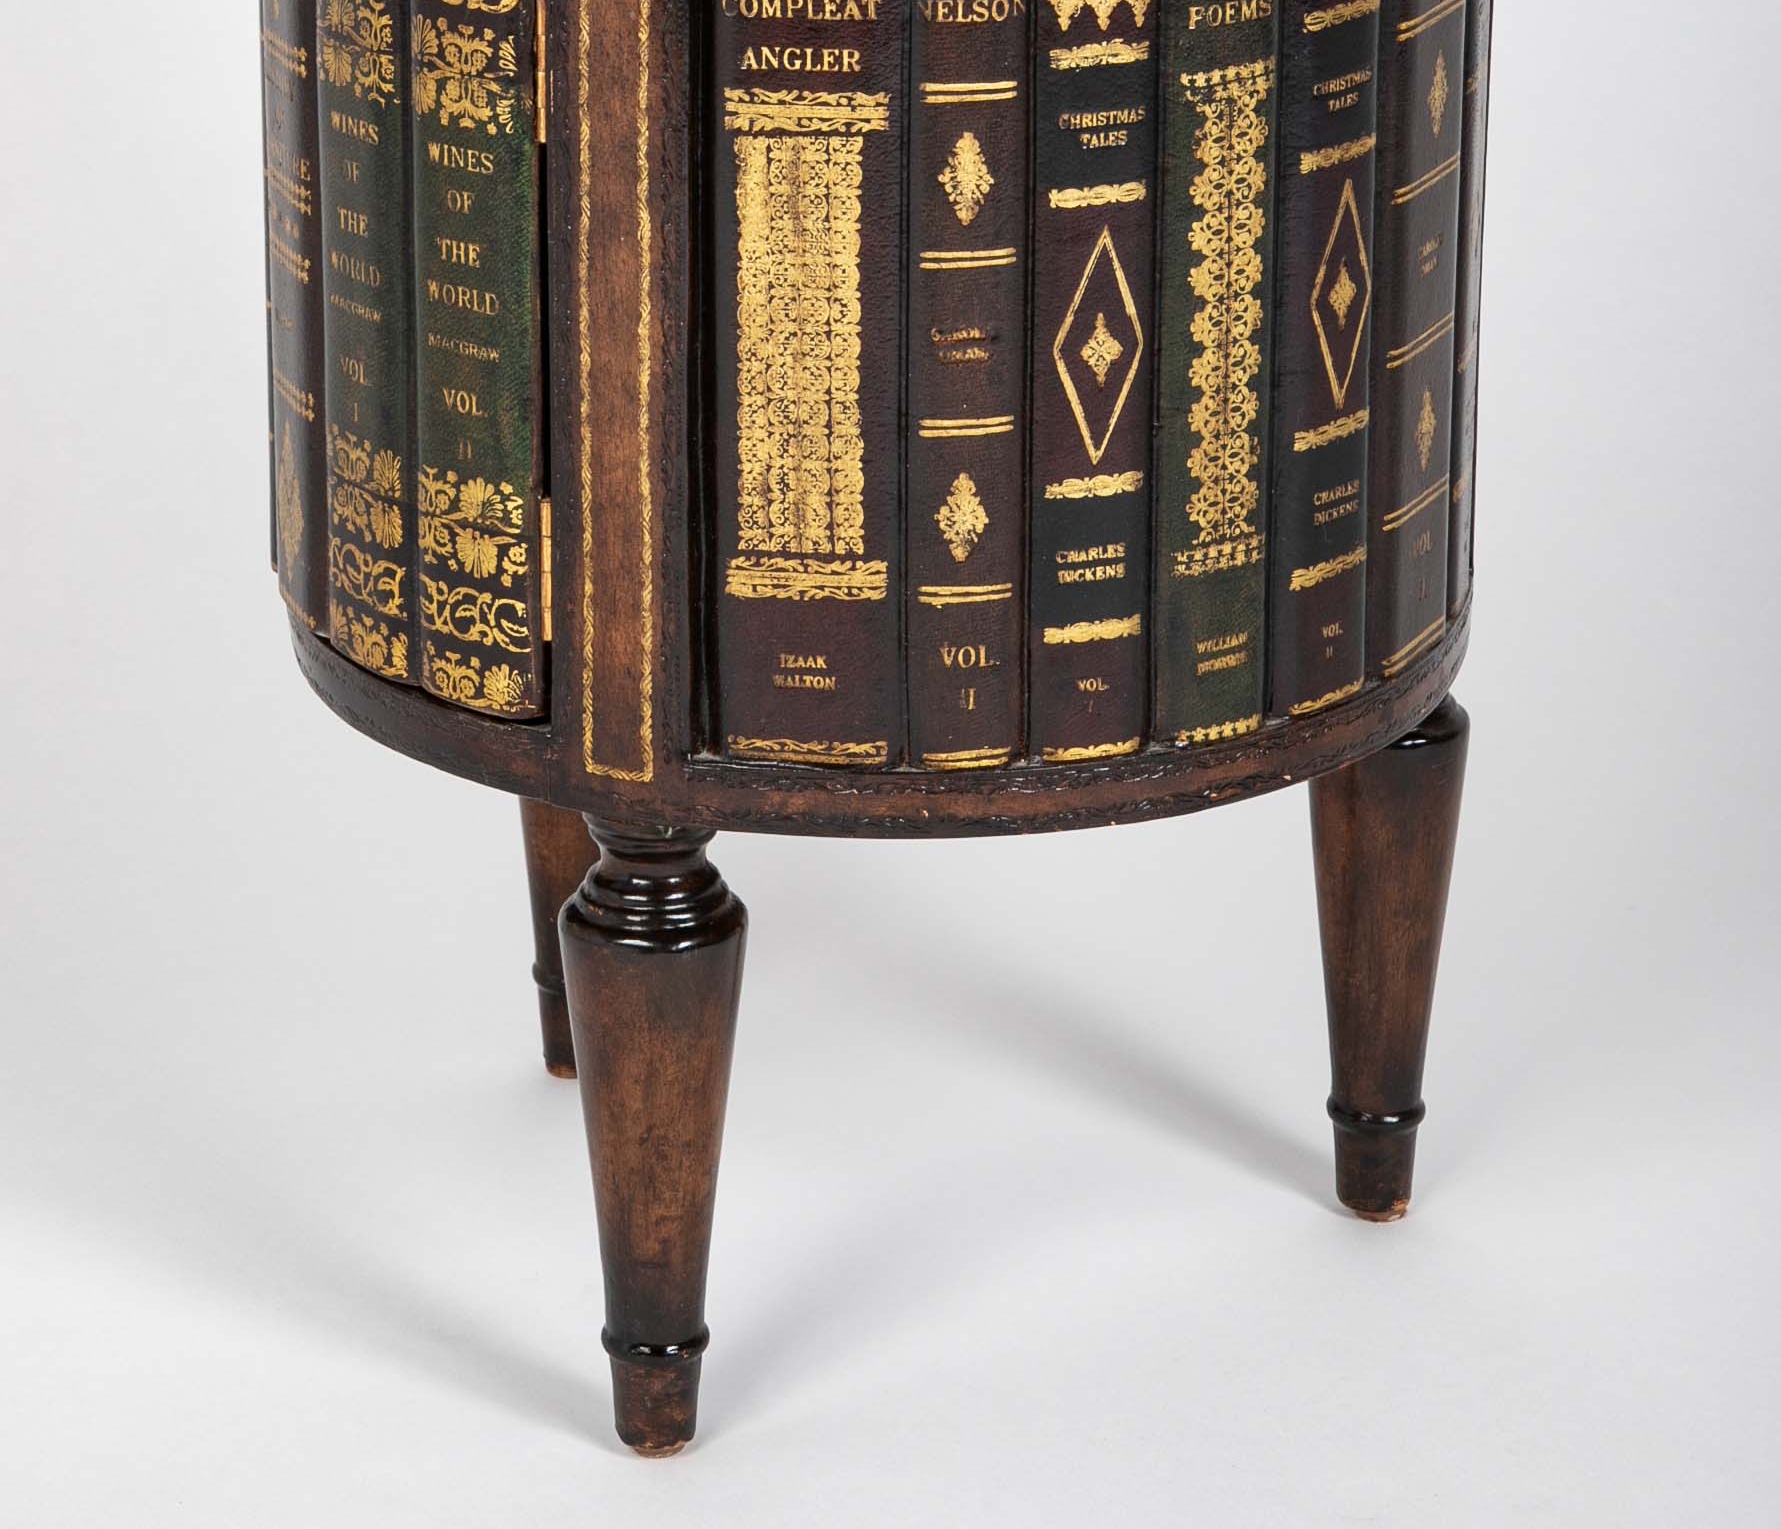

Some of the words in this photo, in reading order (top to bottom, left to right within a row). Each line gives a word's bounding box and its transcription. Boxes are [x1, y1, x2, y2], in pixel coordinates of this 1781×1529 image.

[741, 46, 861, 72] ANGLER
[1313, 68, 1372, 98] CHRISTMAS
[1328, 91, 1359, 113] TALES
[330, 110, 380, 146] WINES
[1058, 105, 1146, 130] CHRISTMAS
[1079, 131, 1127, 149] TALES
[428, 141, 495, 175] WINES
[447, 189, 476, 215] OF
[337, 205, 369, 238] THE
[438, 237, 481, 269] THE
[330, 246, 381, 288] WORLD
[427, 279, 499, 317] WORLD
[428, 332, 500, 363] MACGRAW
[1056, 542, 1126, 564] CHARLES
[1057, 562, 1126, 584] DICKENS
[1196, 631, 1249, 655] WILLIAM
[779, 652, 828, 669] IZAAK
[773, 674, 836, 691] WALTON
